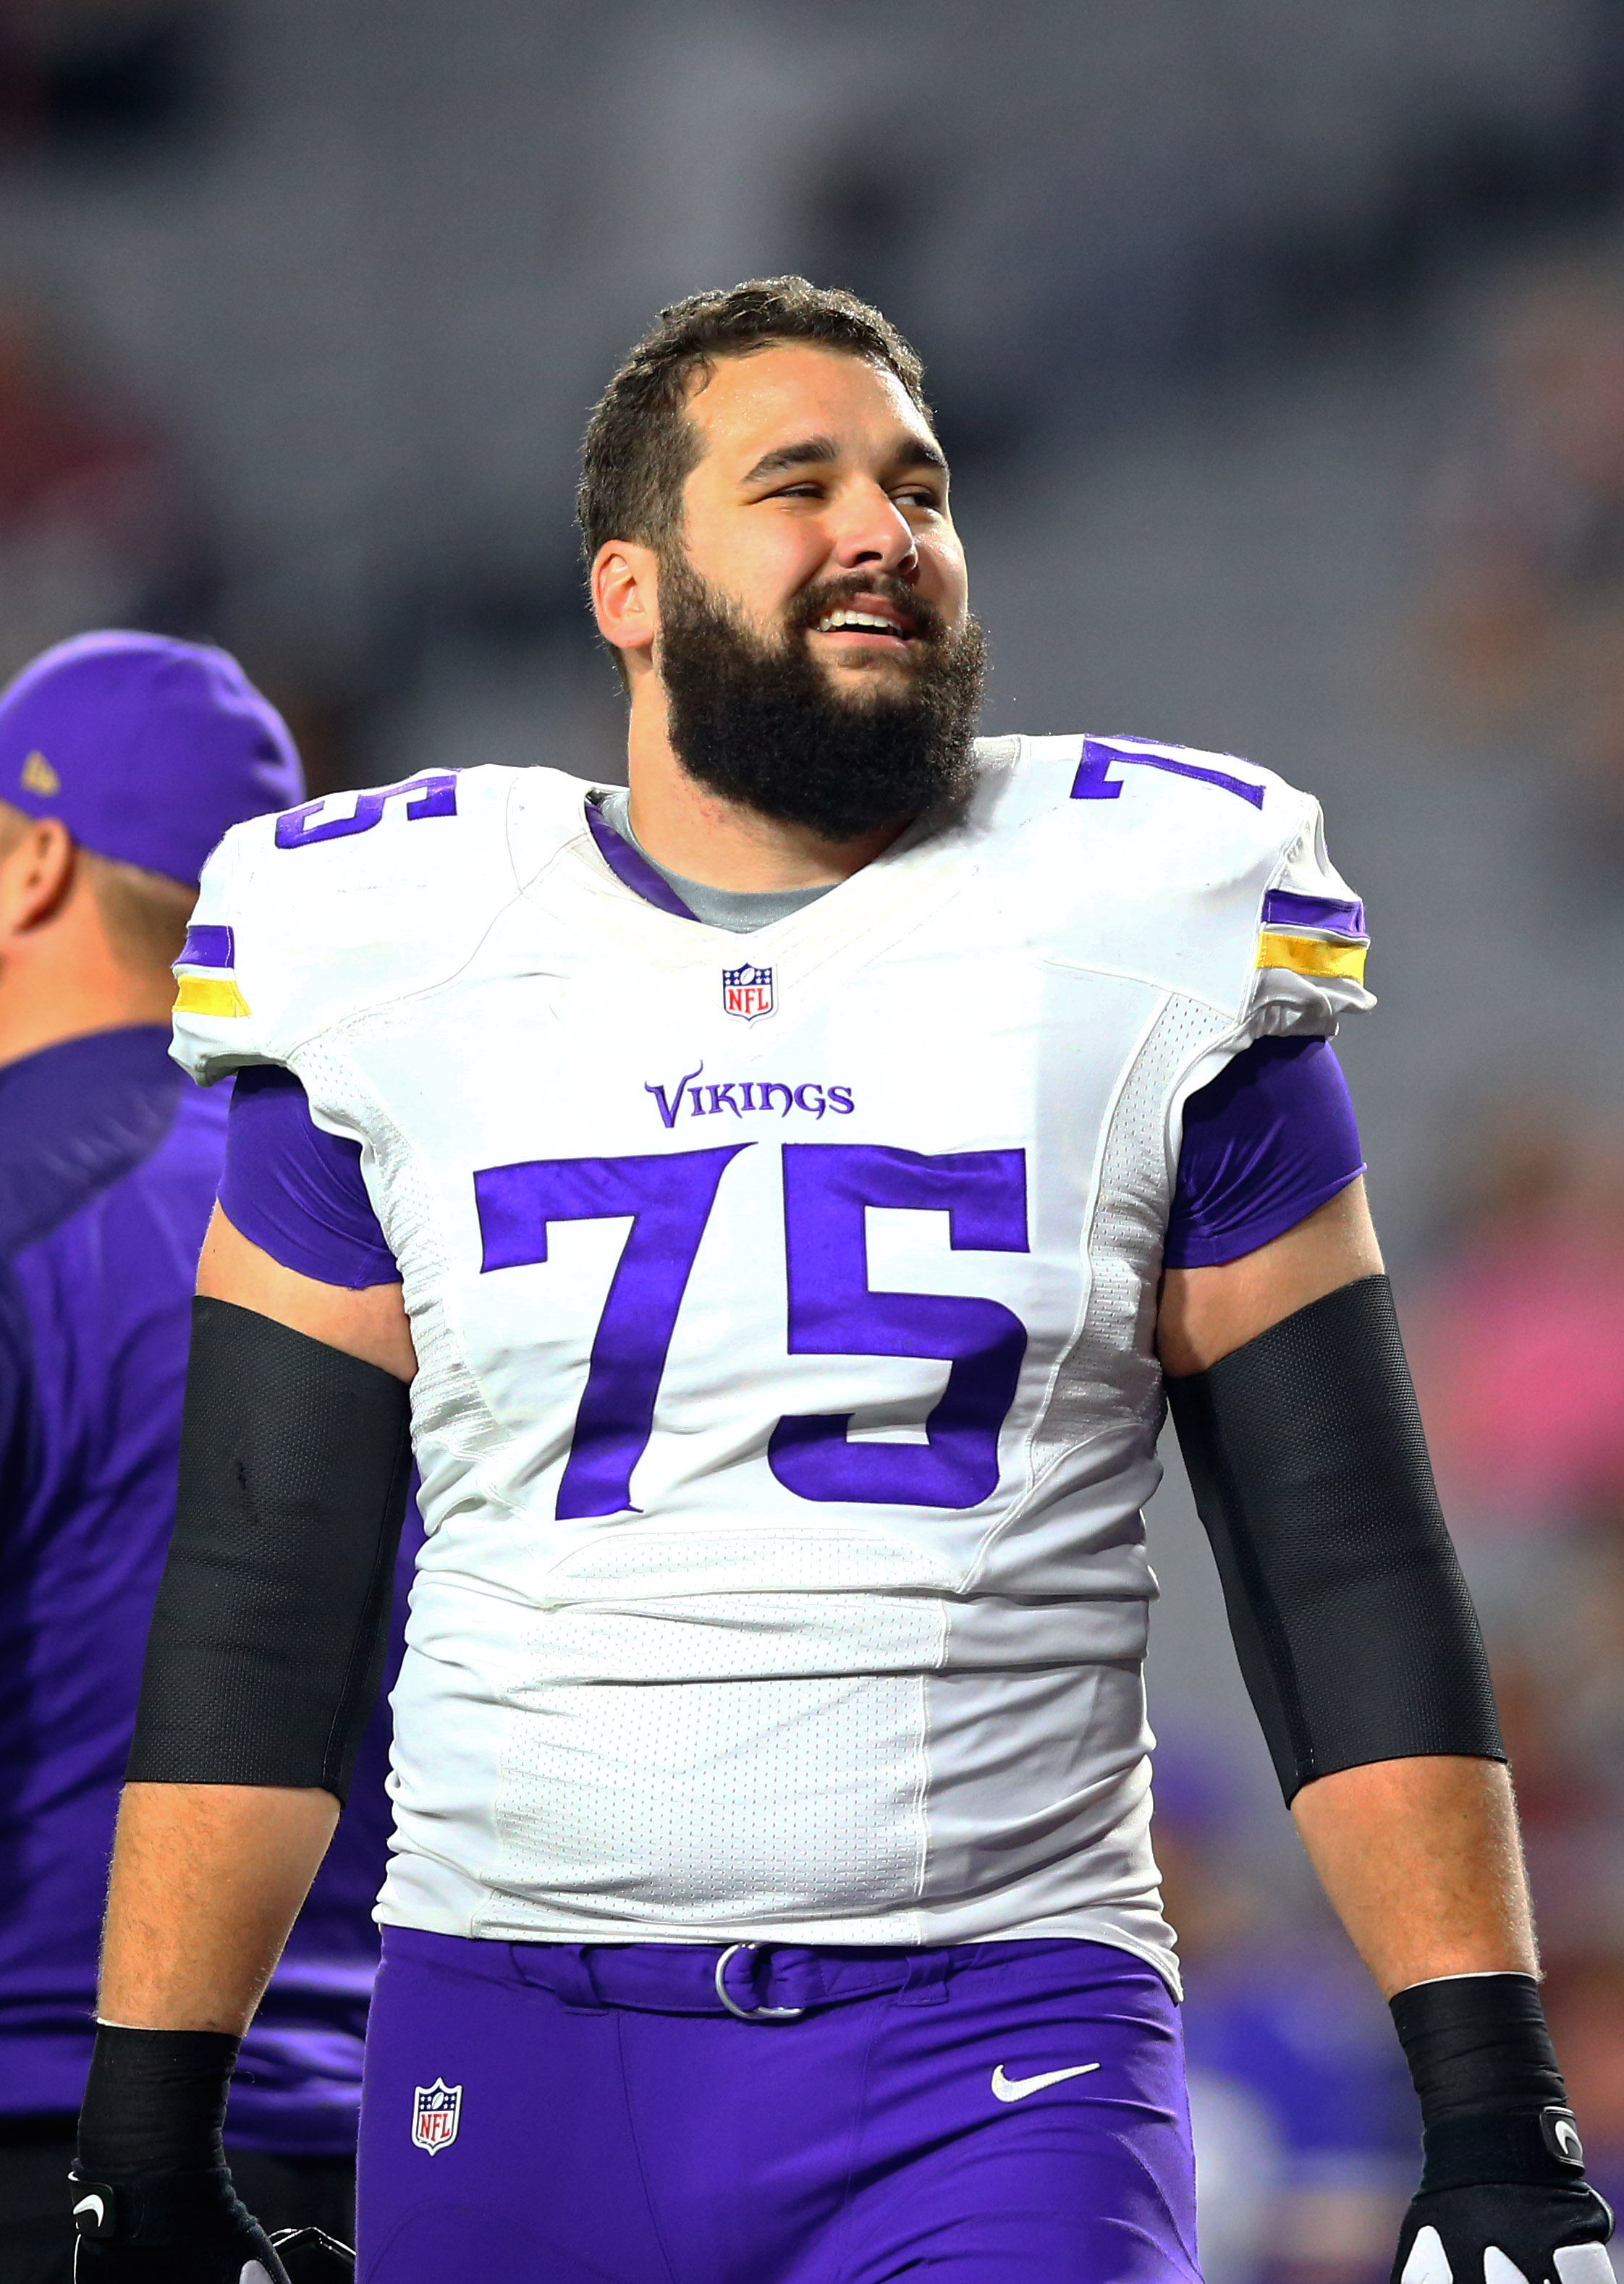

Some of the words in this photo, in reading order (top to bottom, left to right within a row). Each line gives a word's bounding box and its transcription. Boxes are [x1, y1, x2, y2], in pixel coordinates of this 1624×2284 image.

[274, 767, 462, 850] 5
[727, 987, 769, 1014] NFL
[644, 1059, 855, 1129] VIKINGS
[473, 1141, 1031, 1521] 75
[419, 2112, 450, 2141] NFL
